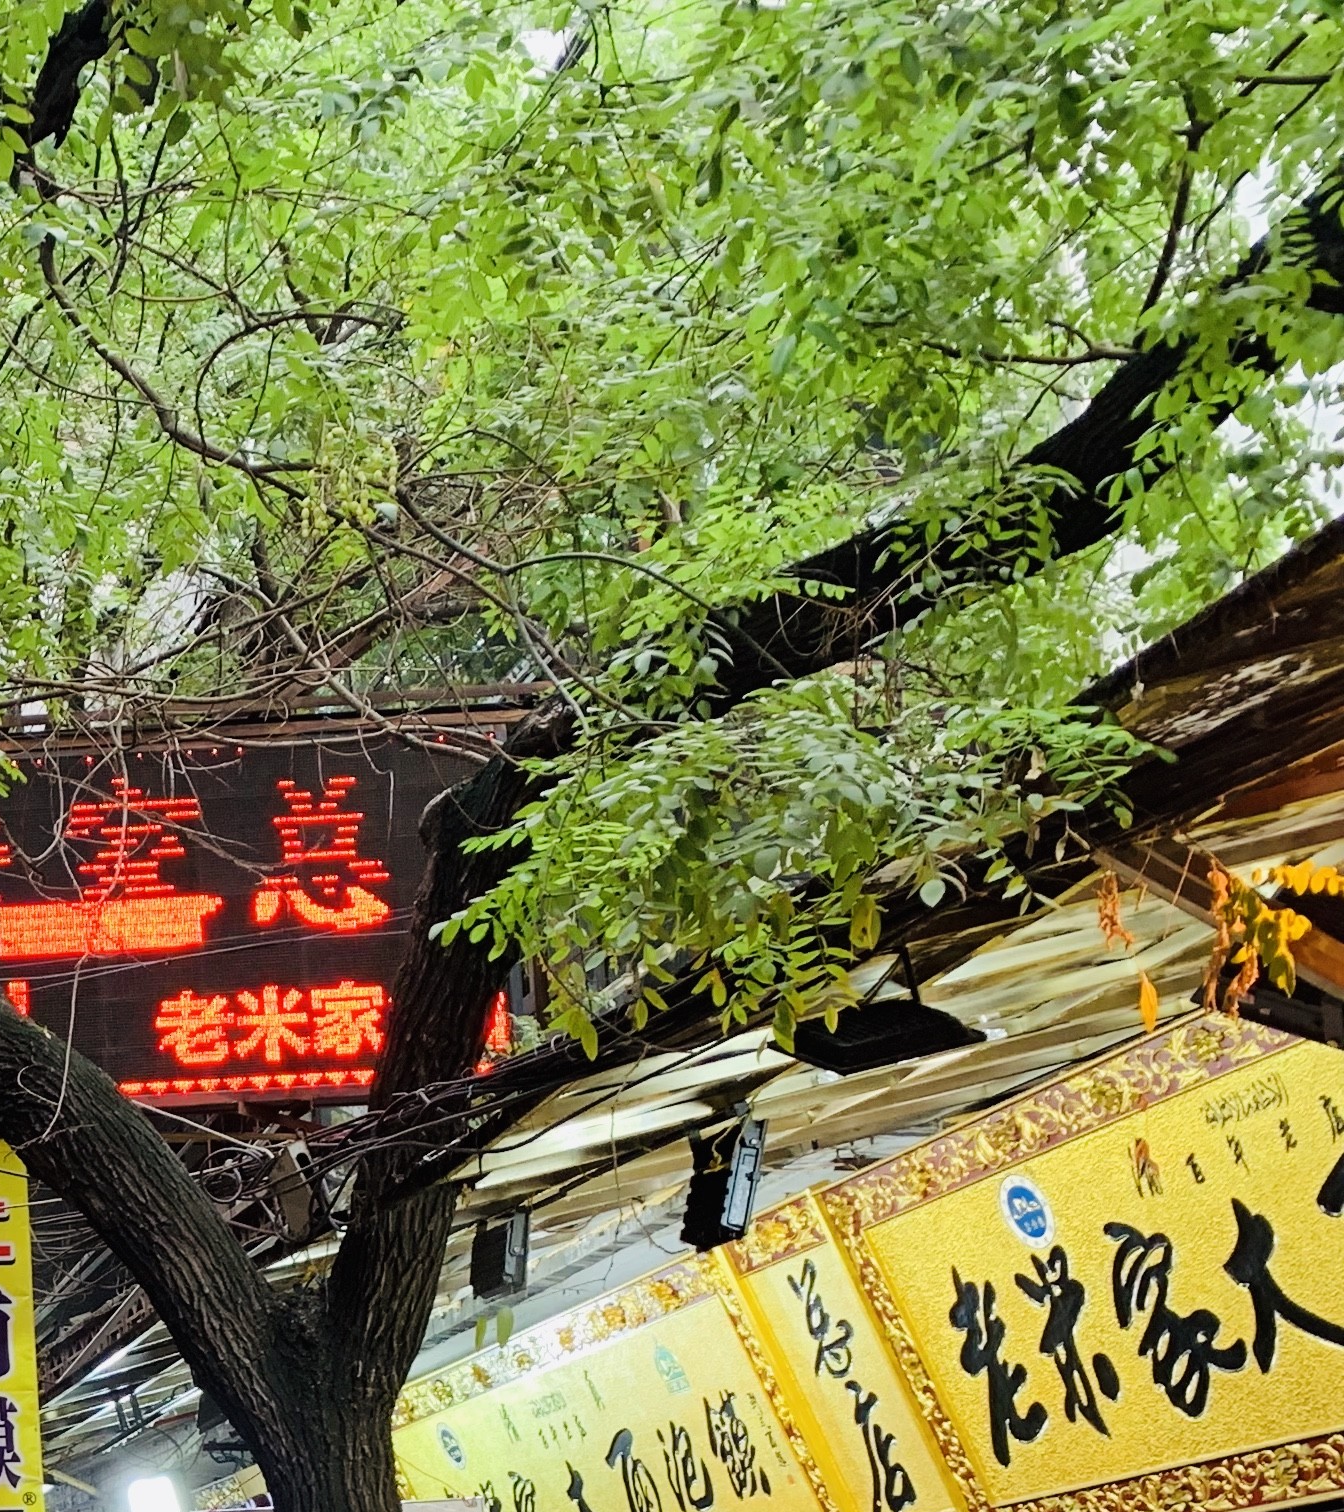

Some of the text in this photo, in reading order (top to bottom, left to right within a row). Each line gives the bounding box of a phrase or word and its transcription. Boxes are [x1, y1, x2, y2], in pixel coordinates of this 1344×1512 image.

[154, 978, 386, 1066] 老米家
[949, 1150, 1344, 1469] 老米家大
